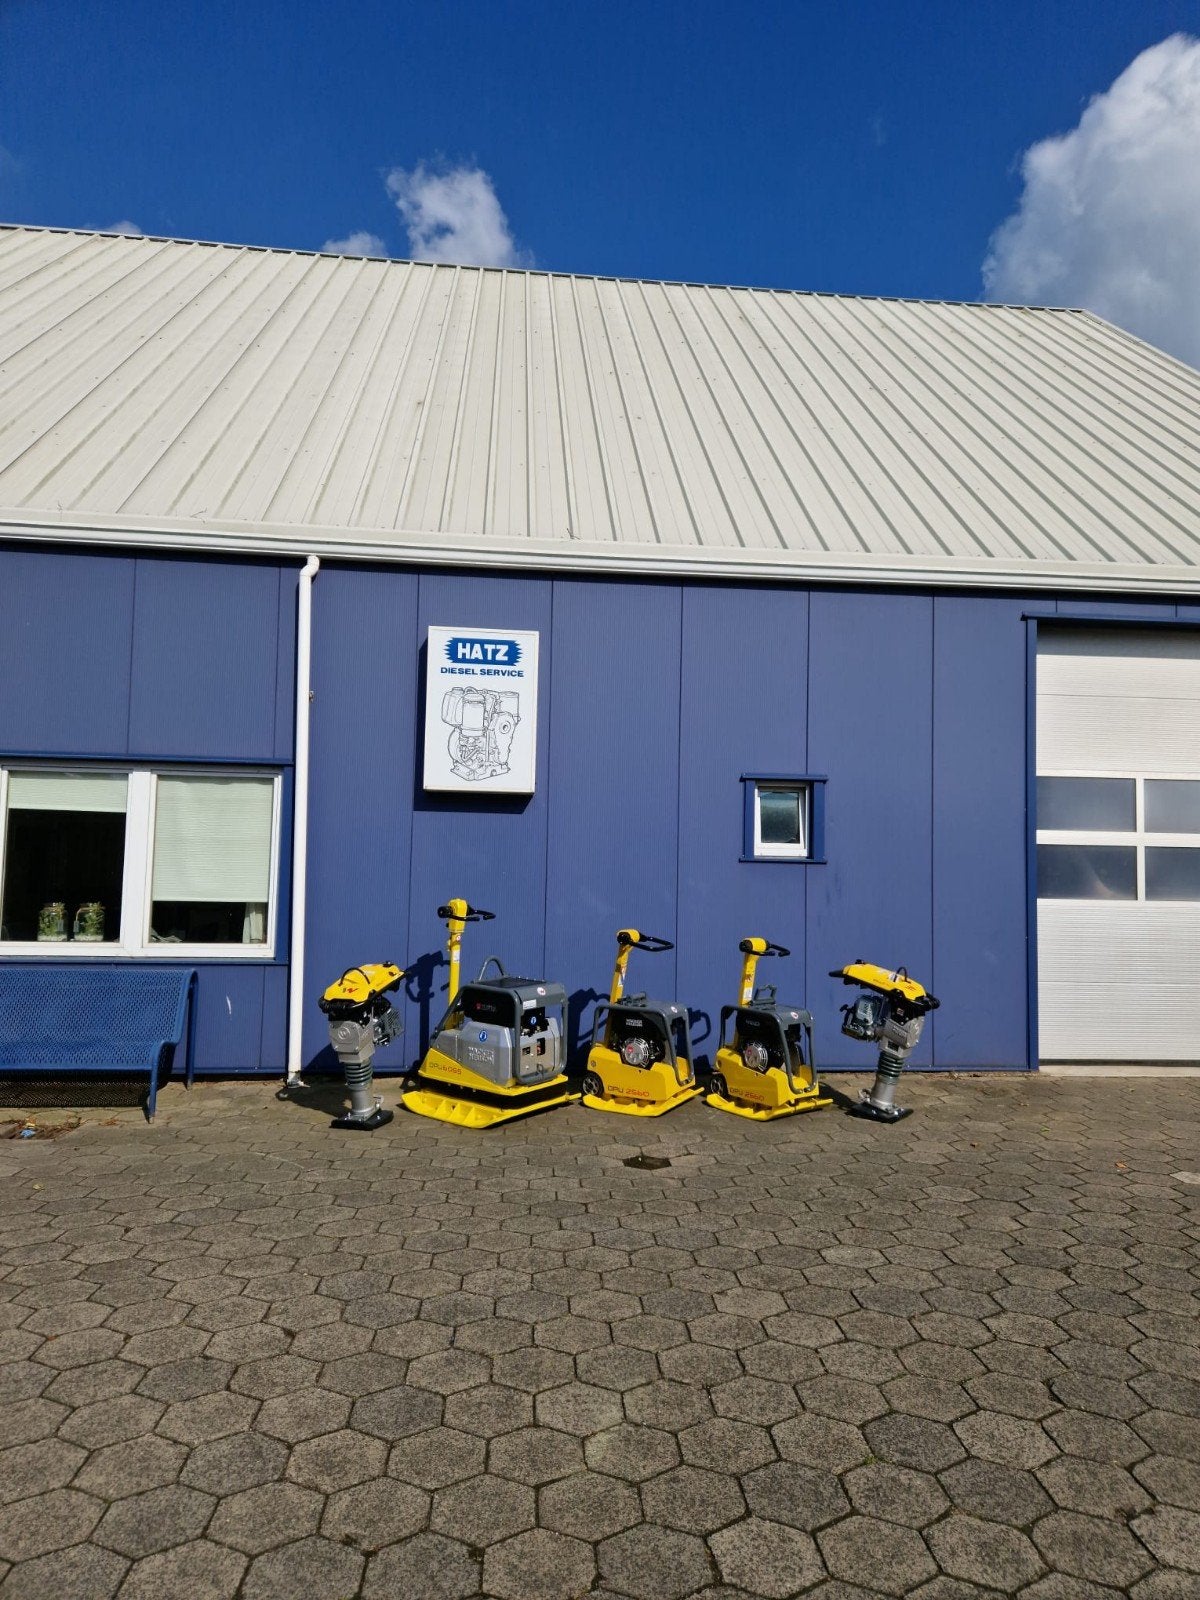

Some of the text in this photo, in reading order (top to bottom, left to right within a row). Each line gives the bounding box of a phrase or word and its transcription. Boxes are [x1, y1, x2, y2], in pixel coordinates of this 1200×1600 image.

[457, 642, 509, 661] HATZ
[440, 667, 524, 677] DIESEL SERVICE
